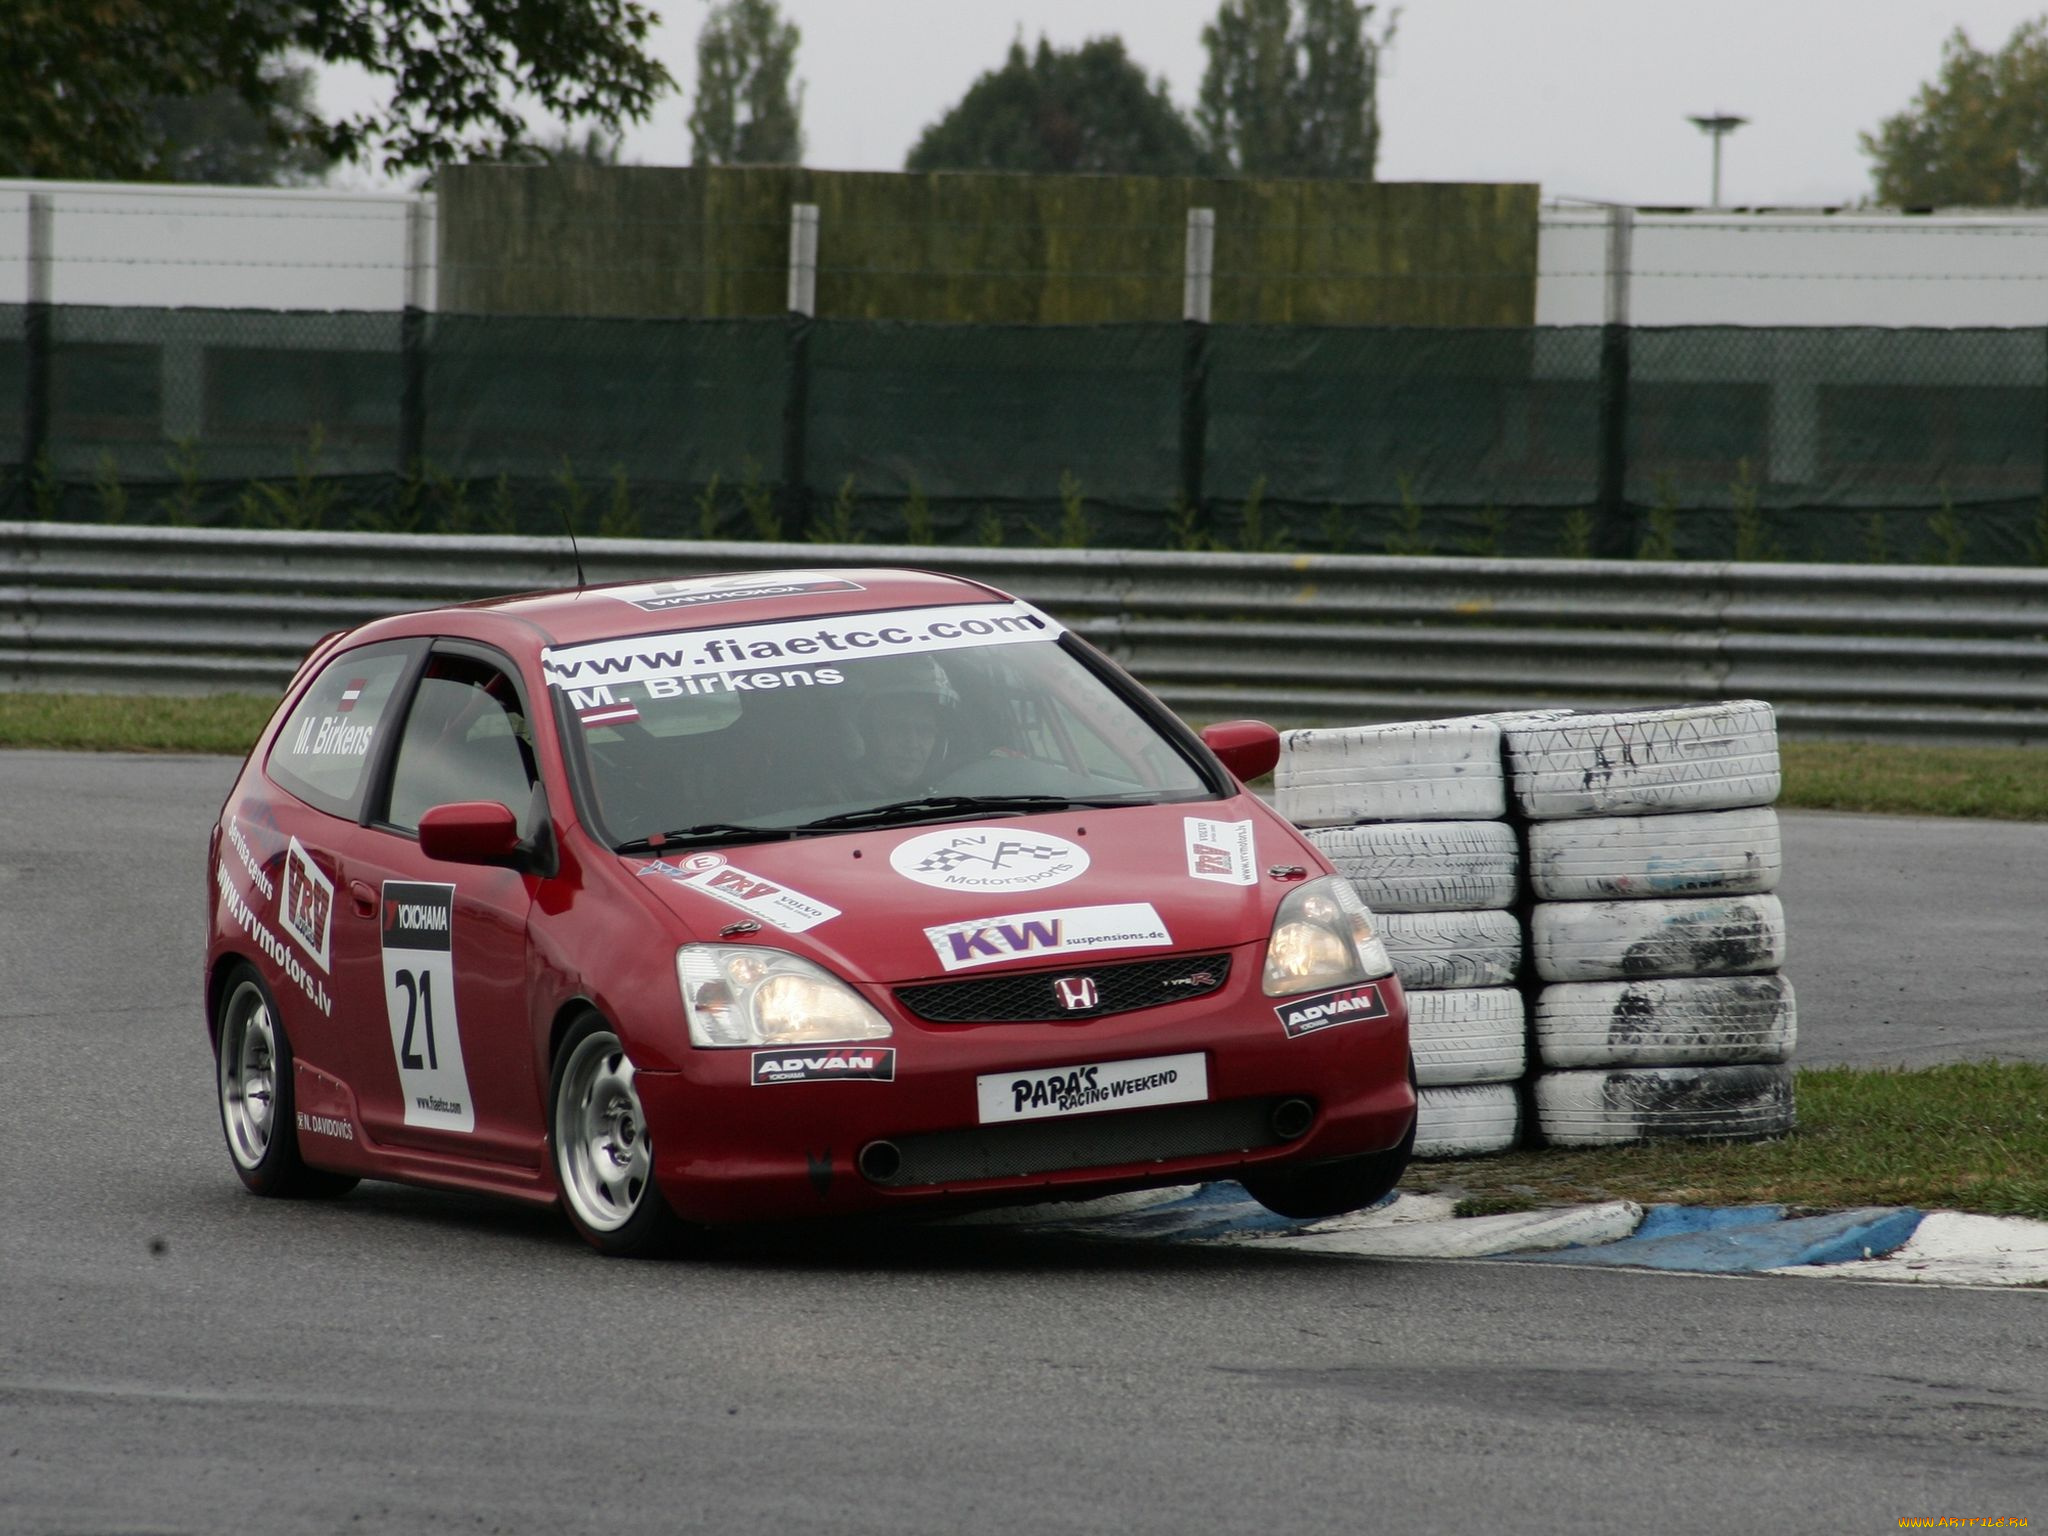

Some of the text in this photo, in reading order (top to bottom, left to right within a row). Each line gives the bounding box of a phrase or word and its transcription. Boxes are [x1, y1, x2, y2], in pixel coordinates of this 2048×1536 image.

[543, 613, 1045, 680] www.fiaetcc.com
[567, 667, 845, 710] M. Birkens
[293, 716, 373, 755] M. Birkens
[951, 835, 986, 848] AV
[944, 862, 1073, 886] Motorsports
[398, 904, 448, 931] YOKOHAMA
[780, 896, 823, 917] VOLVO
[217, 858, 333, 1017] www.vrvmotors.lv
[949, 918, 1165, 961] KW suspensions.de
[395, 969, 438, 1070] 21
[1288, 996, 1371, 1025] ADVAN
[758, 1057, 873, 1073] ADVAN
[1012, 1067, 1098, 1112] PAPA'S
[1059, 1069, 1178, 1111] RACING WEEKEND
